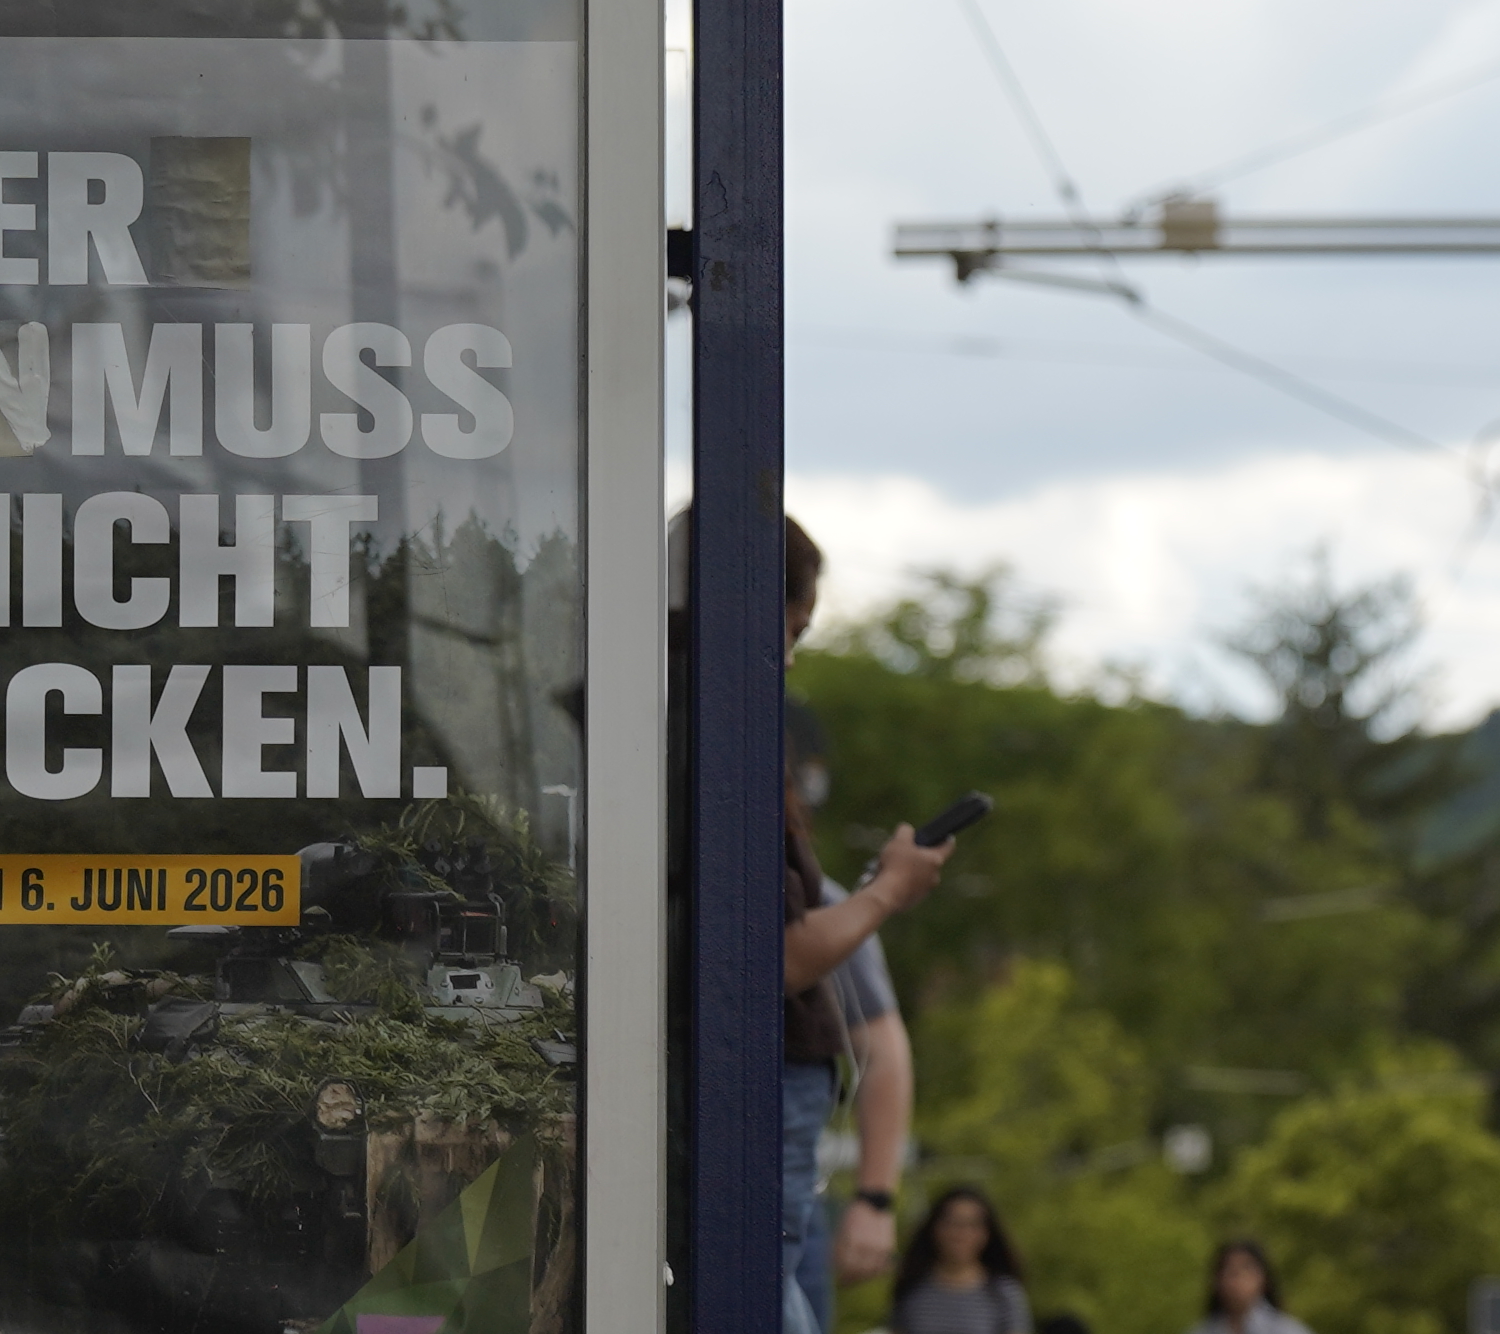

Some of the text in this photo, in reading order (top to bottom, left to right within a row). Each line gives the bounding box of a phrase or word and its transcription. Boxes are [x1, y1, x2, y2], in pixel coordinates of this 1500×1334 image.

[70, 321, 515, 461] MUSS
[21, 867, 55, 912] 6.
[70, 867, 167, 912] JUNI
[183, 868, 284, 913] 2026
